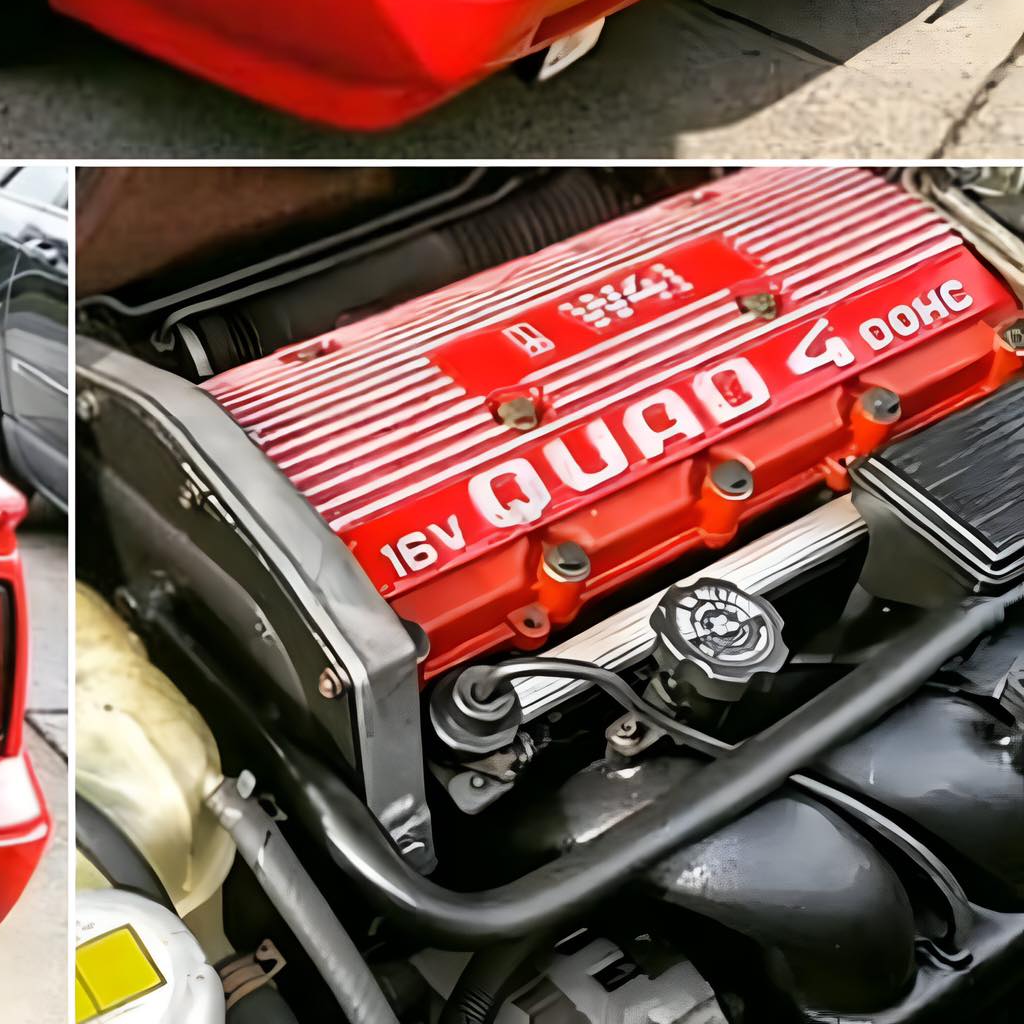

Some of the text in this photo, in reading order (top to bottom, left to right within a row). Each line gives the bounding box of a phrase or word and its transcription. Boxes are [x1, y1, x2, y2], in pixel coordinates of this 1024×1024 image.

[380, 514, 466, 577] 16V
[468, 357, 770, 528] QUAD
[787, 318, 855, 375] 4
